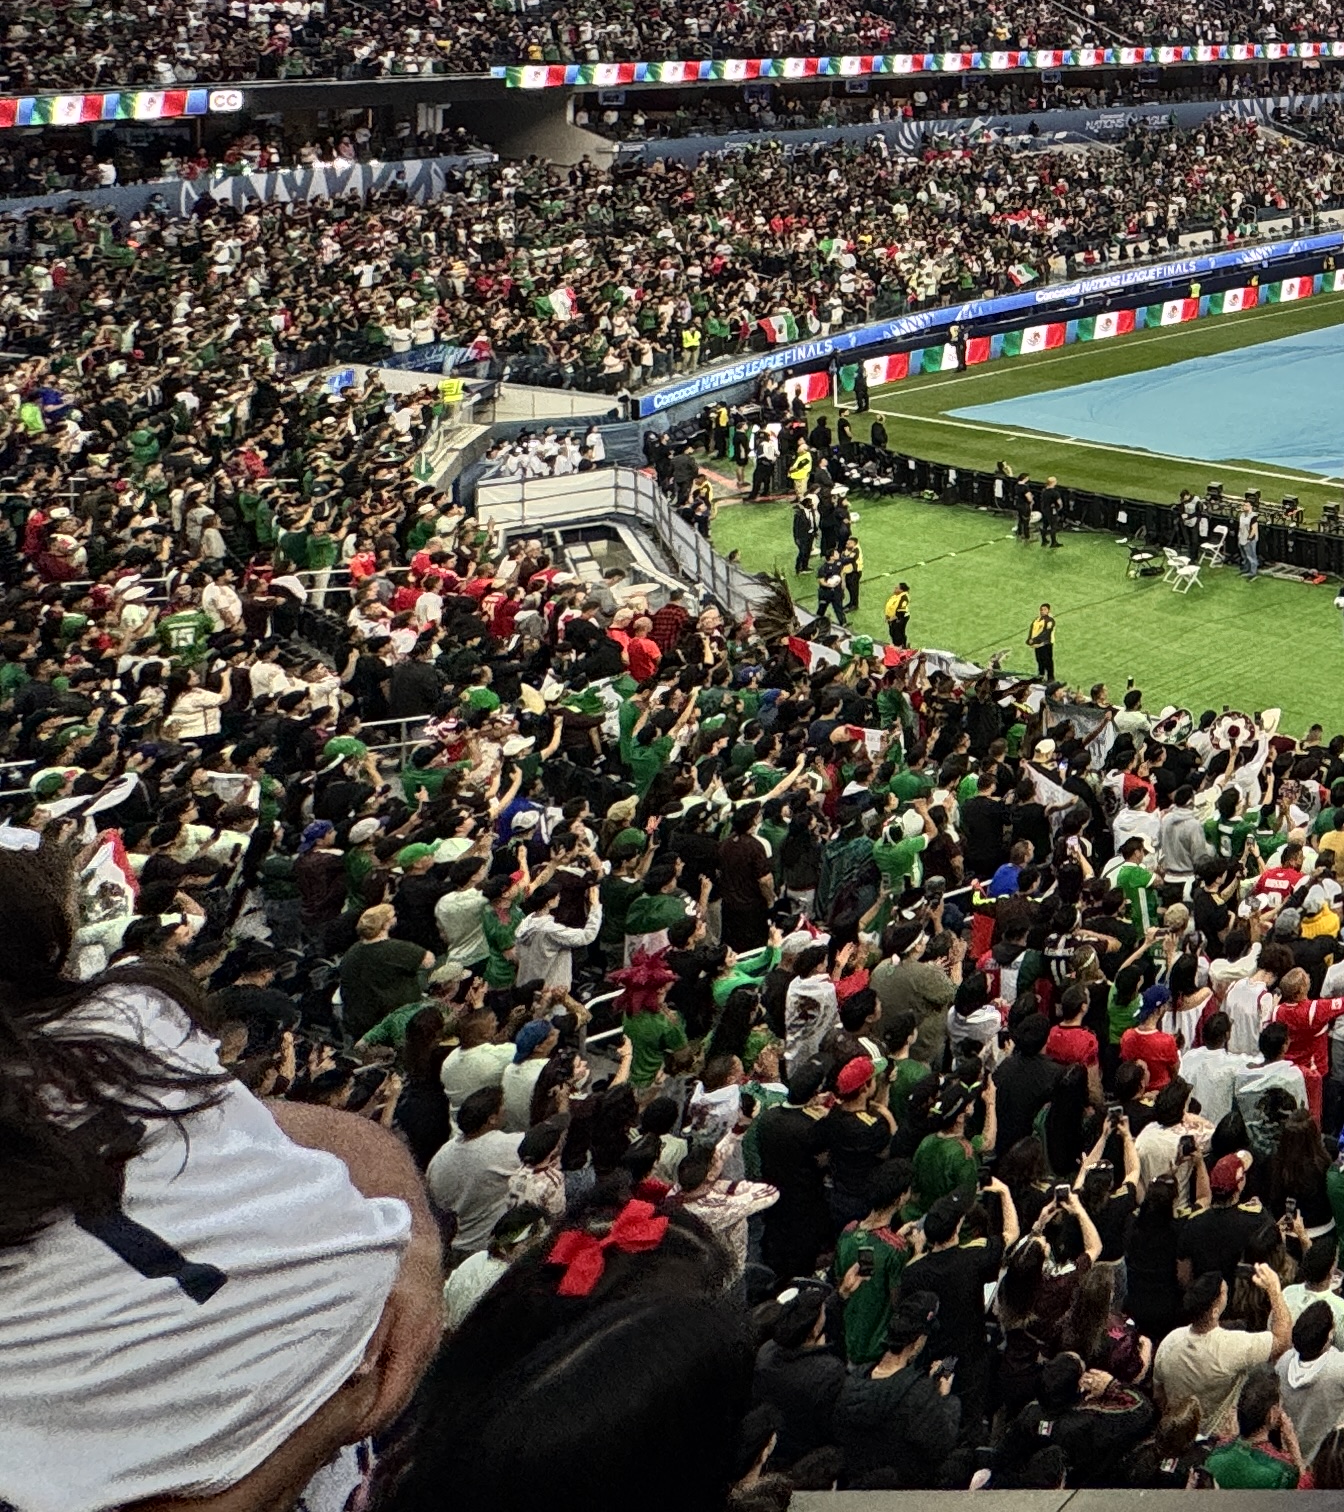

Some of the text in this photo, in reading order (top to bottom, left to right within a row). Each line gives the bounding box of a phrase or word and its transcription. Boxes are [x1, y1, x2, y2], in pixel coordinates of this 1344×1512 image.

[213, 94, 239, 108] CC
[1121, 269, 1156, 286] LEAGUE
[1154, 261, 1196, 278] FINALS
[654, 380, 700, 409] Concacaf
[745, 354, 785, 377] LEAGUE
[783, 339, 833, 364] FINALS
